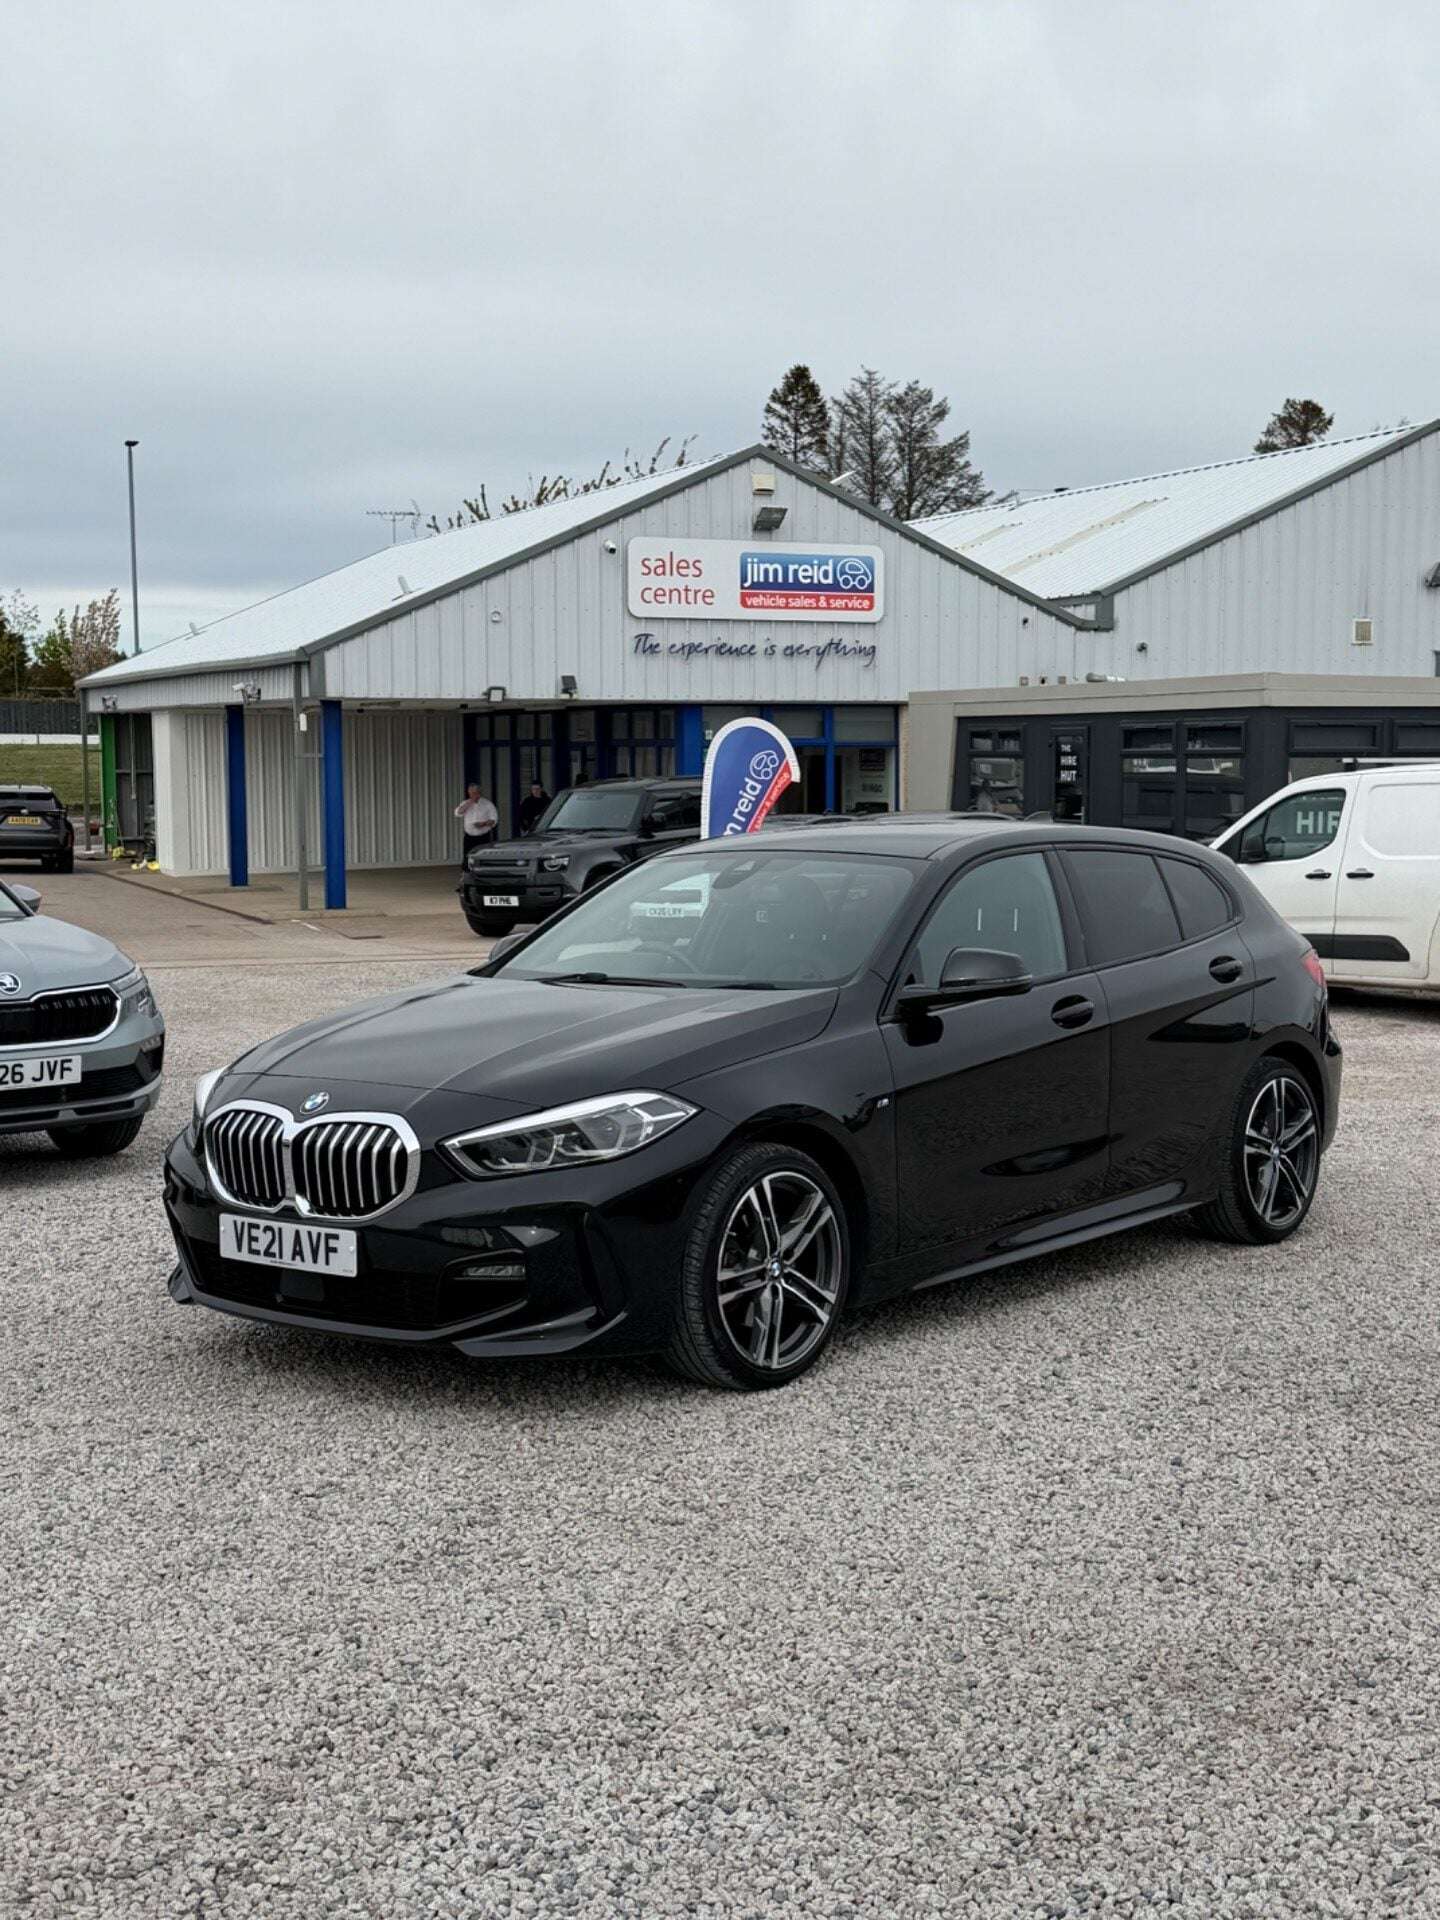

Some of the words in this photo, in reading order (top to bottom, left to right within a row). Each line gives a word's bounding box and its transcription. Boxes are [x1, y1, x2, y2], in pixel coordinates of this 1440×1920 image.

[641, 551, 703, 578] sales
[744, 558, 783, 588] jim
[788, 559, 833, 585] reid
[641, 585, 715, 606] centre
[745, 594, 786, 607] vehicle
[788, 596, 817, 608] sales
[818, 596, 828, 608] &
[829, 597, 870, 609] service
[634, 633, 662, 655] The
[669, 636, 757, 661] experience
[764, 637, 777, 656] is
[783, 637, 877, 672] everything
[1061, 744, 1072, 752] THE
[1061, 755, 1077, 766] HIRE
[1061, 770, 1077, 781] HUT
[732, 777, 762, 822] reid
[0, 1063, 24, 1085] 26
[31, 1058, 72, 1082] JVF
[233, 1219, 283, 1260] VE21
[291, 1229, 340, 1267] AVF
